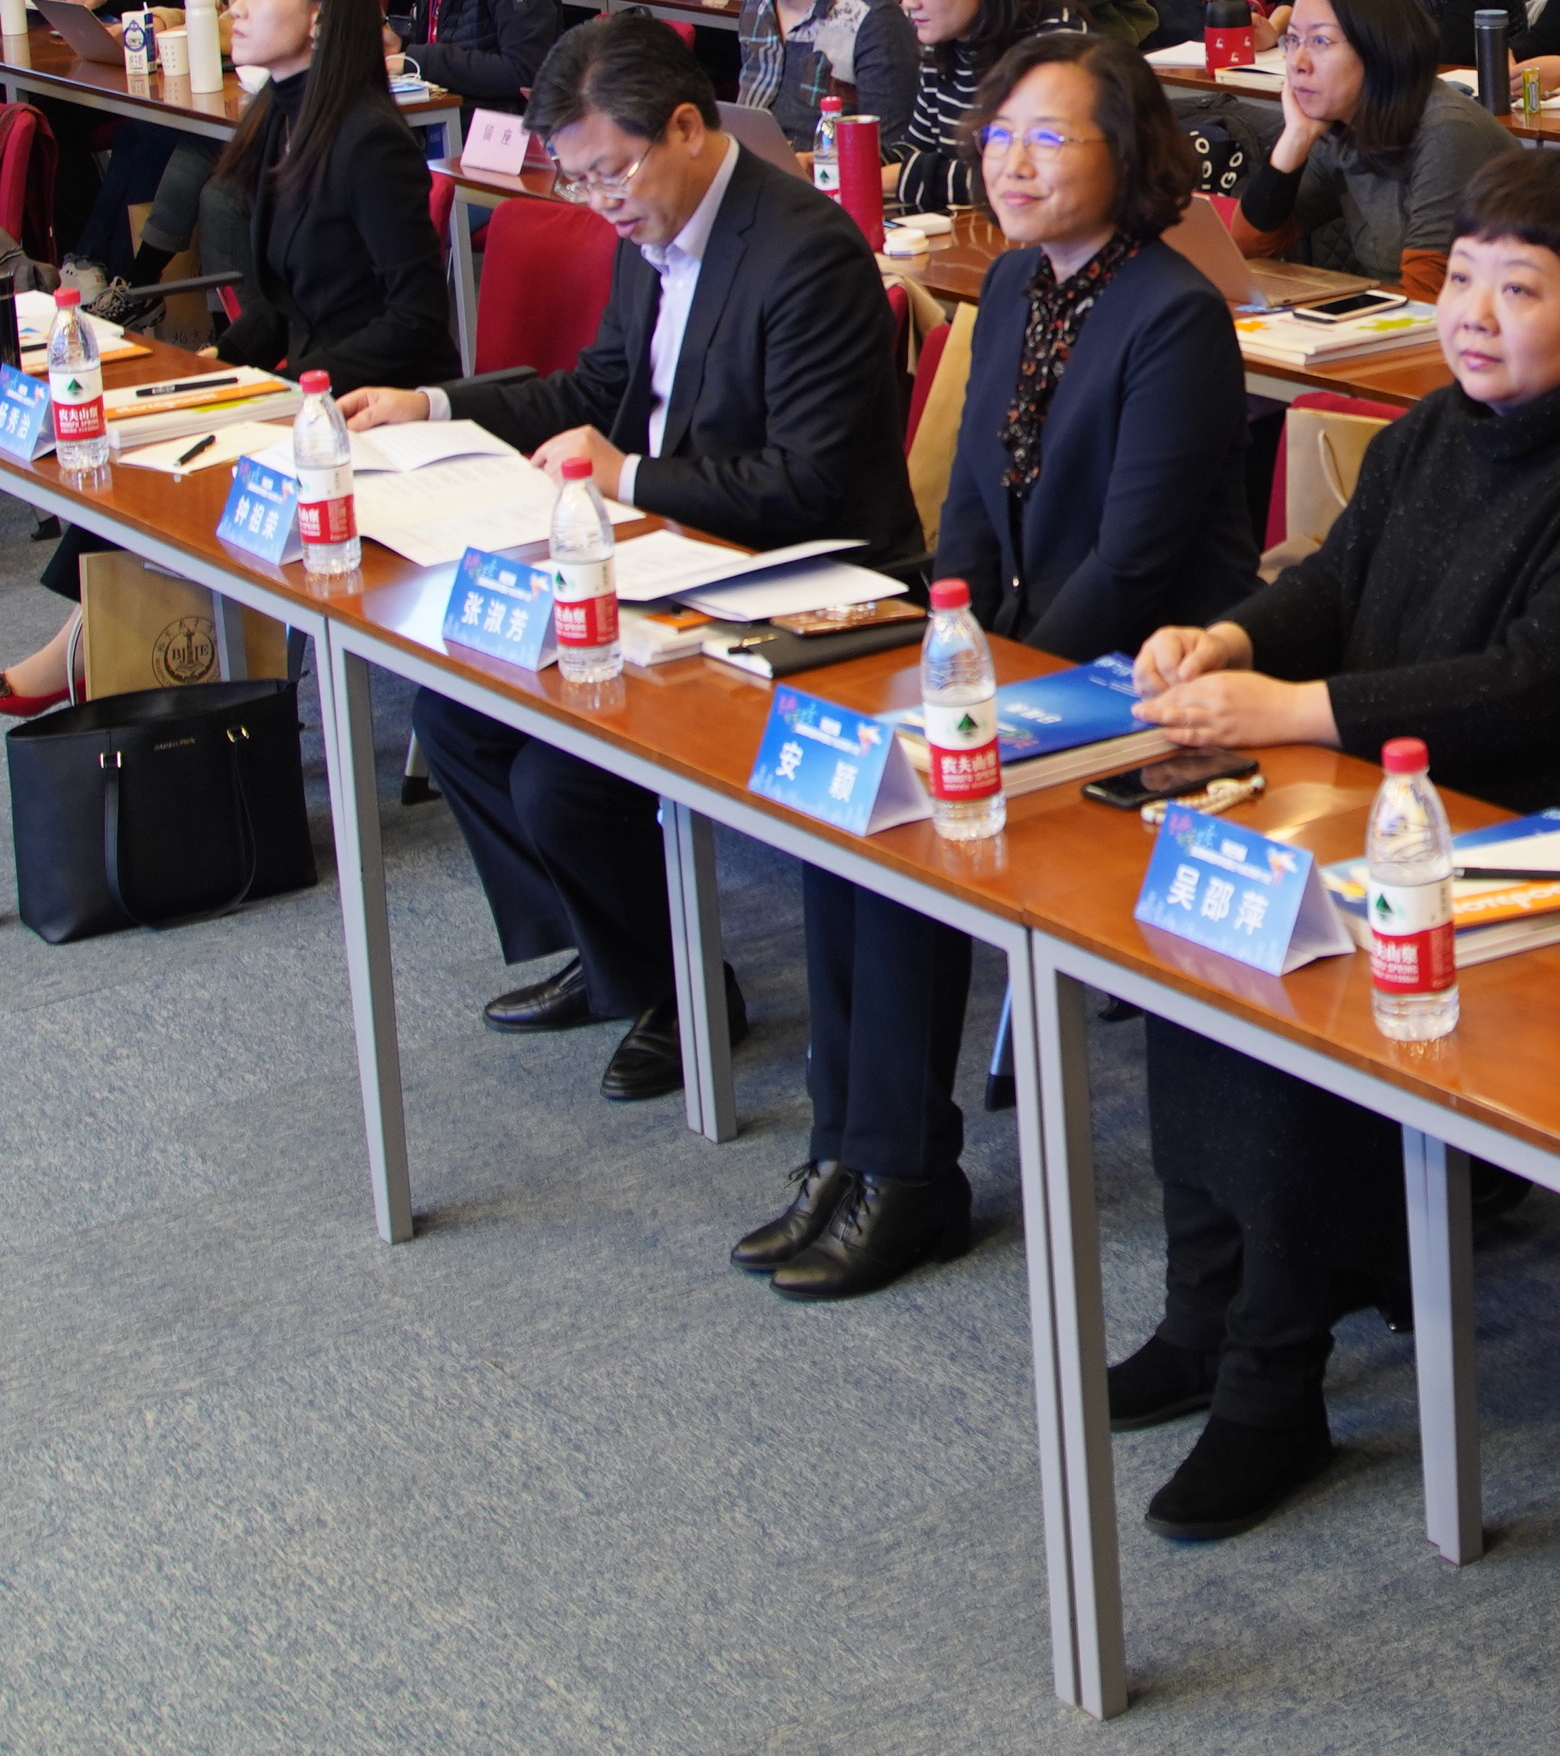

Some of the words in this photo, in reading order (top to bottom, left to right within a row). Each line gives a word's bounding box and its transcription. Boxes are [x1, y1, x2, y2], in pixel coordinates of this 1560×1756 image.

[234, 494, 280, 540] 钟祖荣
[461, 590, 530, 643] 张淑芳
[1166, 862, 1270, 936] 吴邵萍
